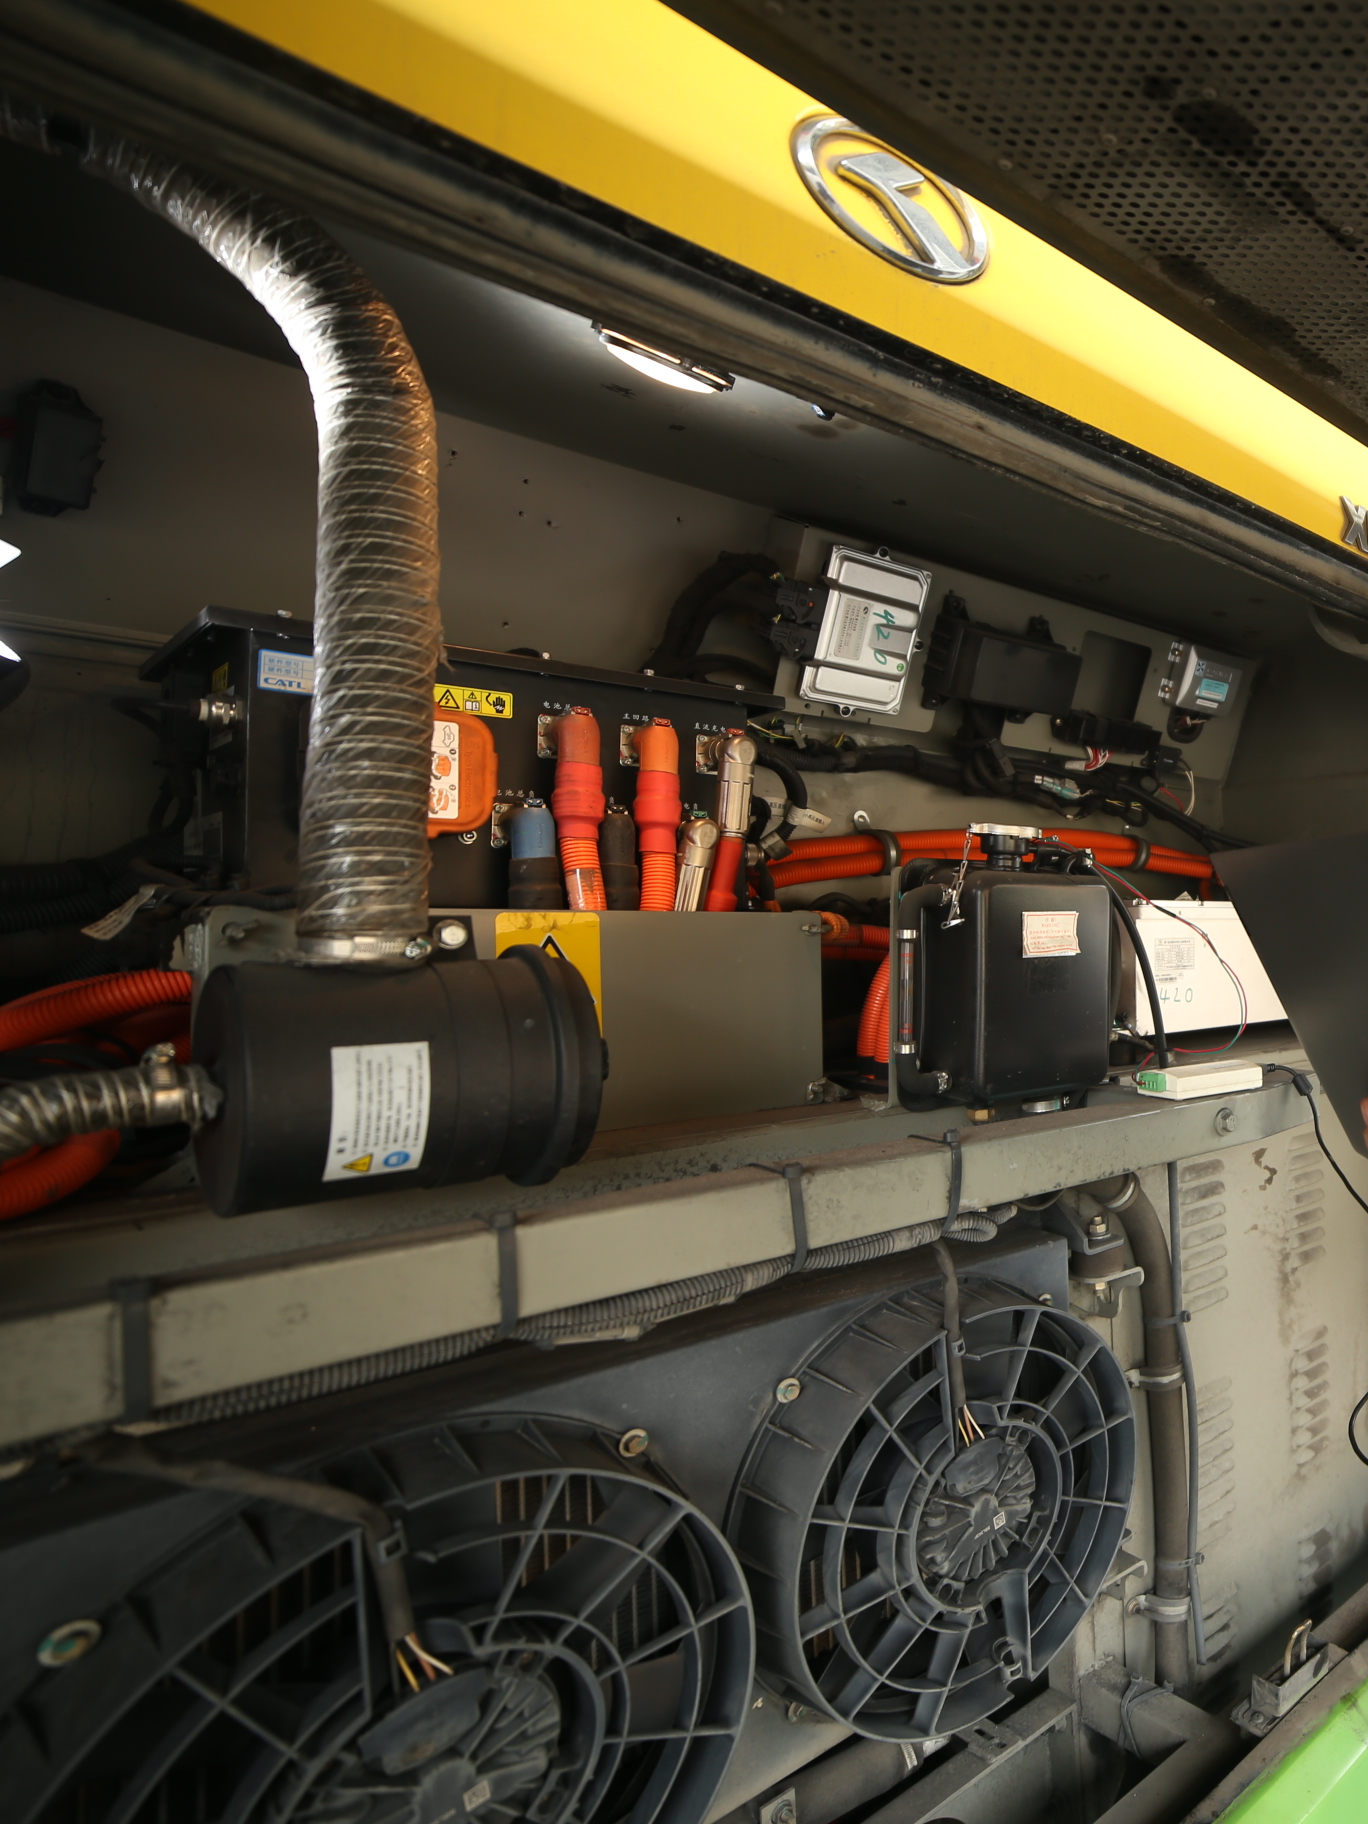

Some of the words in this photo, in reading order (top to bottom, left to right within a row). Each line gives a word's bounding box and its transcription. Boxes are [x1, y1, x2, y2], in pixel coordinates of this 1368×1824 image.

[873, 609, 895, 665] 420
[263, 677, 306, 689] CATL
[1159, 987, 1193, 1004] 420
